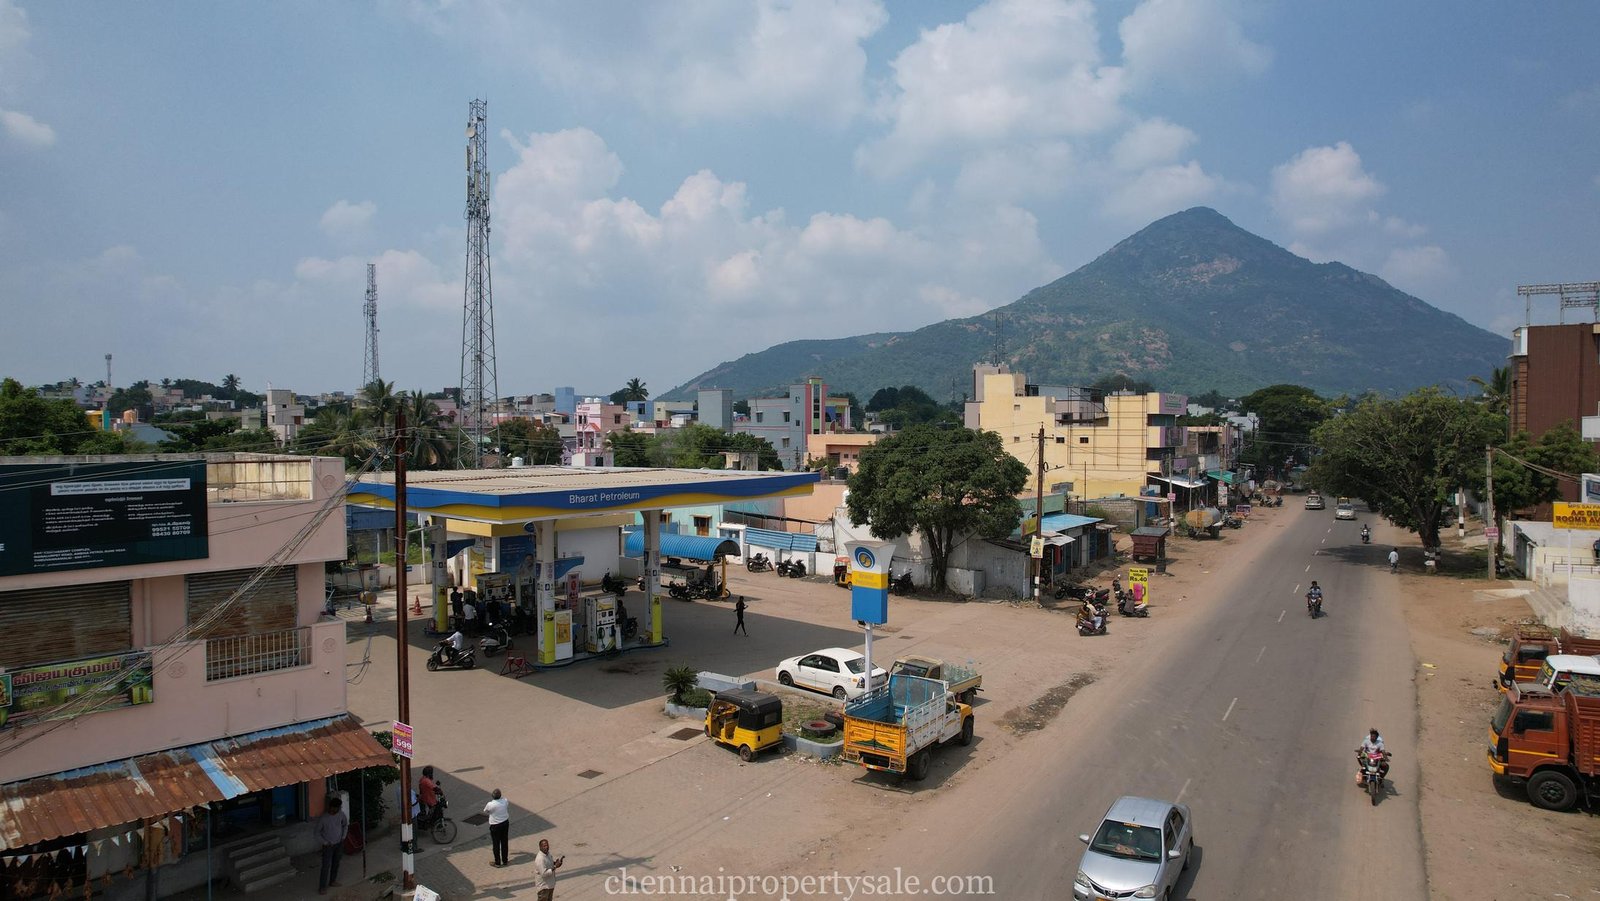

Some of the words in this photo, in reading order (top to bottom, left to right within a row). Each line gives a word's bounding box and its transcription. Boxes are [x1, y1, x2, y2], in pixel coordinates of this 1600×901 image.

[569, 494, 598, 504] Bharat
[600, 492, 640, 501] Petroleum
[13, 659, 120, 686] விஜயகுமார்
[396, 738, 412, 750] 599
